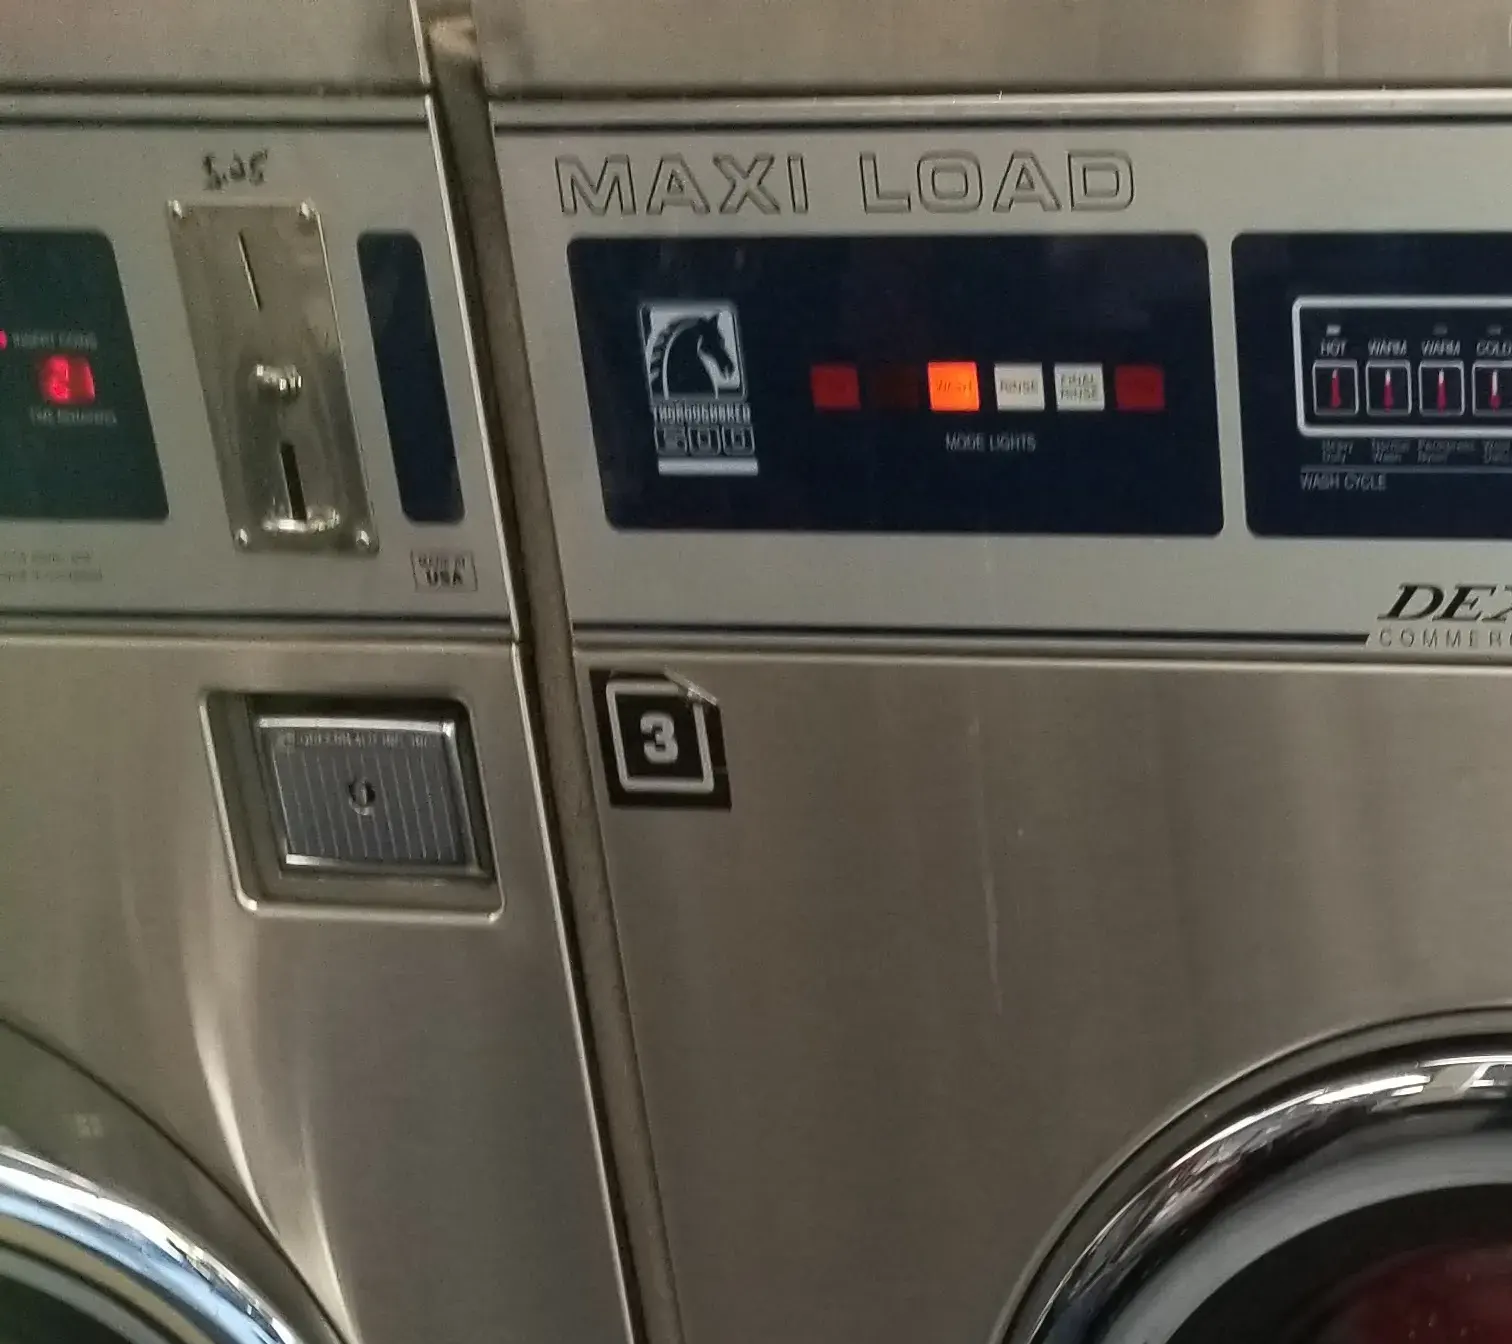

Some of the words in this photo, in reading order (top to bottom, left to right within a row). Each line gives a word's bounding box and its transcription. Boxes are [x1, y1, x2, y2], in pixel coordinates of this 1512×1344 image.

[554, 152, 810, 216] MAXI
[858, 149, 1135, 215] LOAD
[1320, 338, 1348, 357] HOT
[945, 432, 983, 452] MODE
[989, 432, 1038, 452] LIGHTS
[1301, 472, 1340, 491] WASH
[1343, 472, 1388, 491] CYCLE
[639, 711, 679, 765] 3
